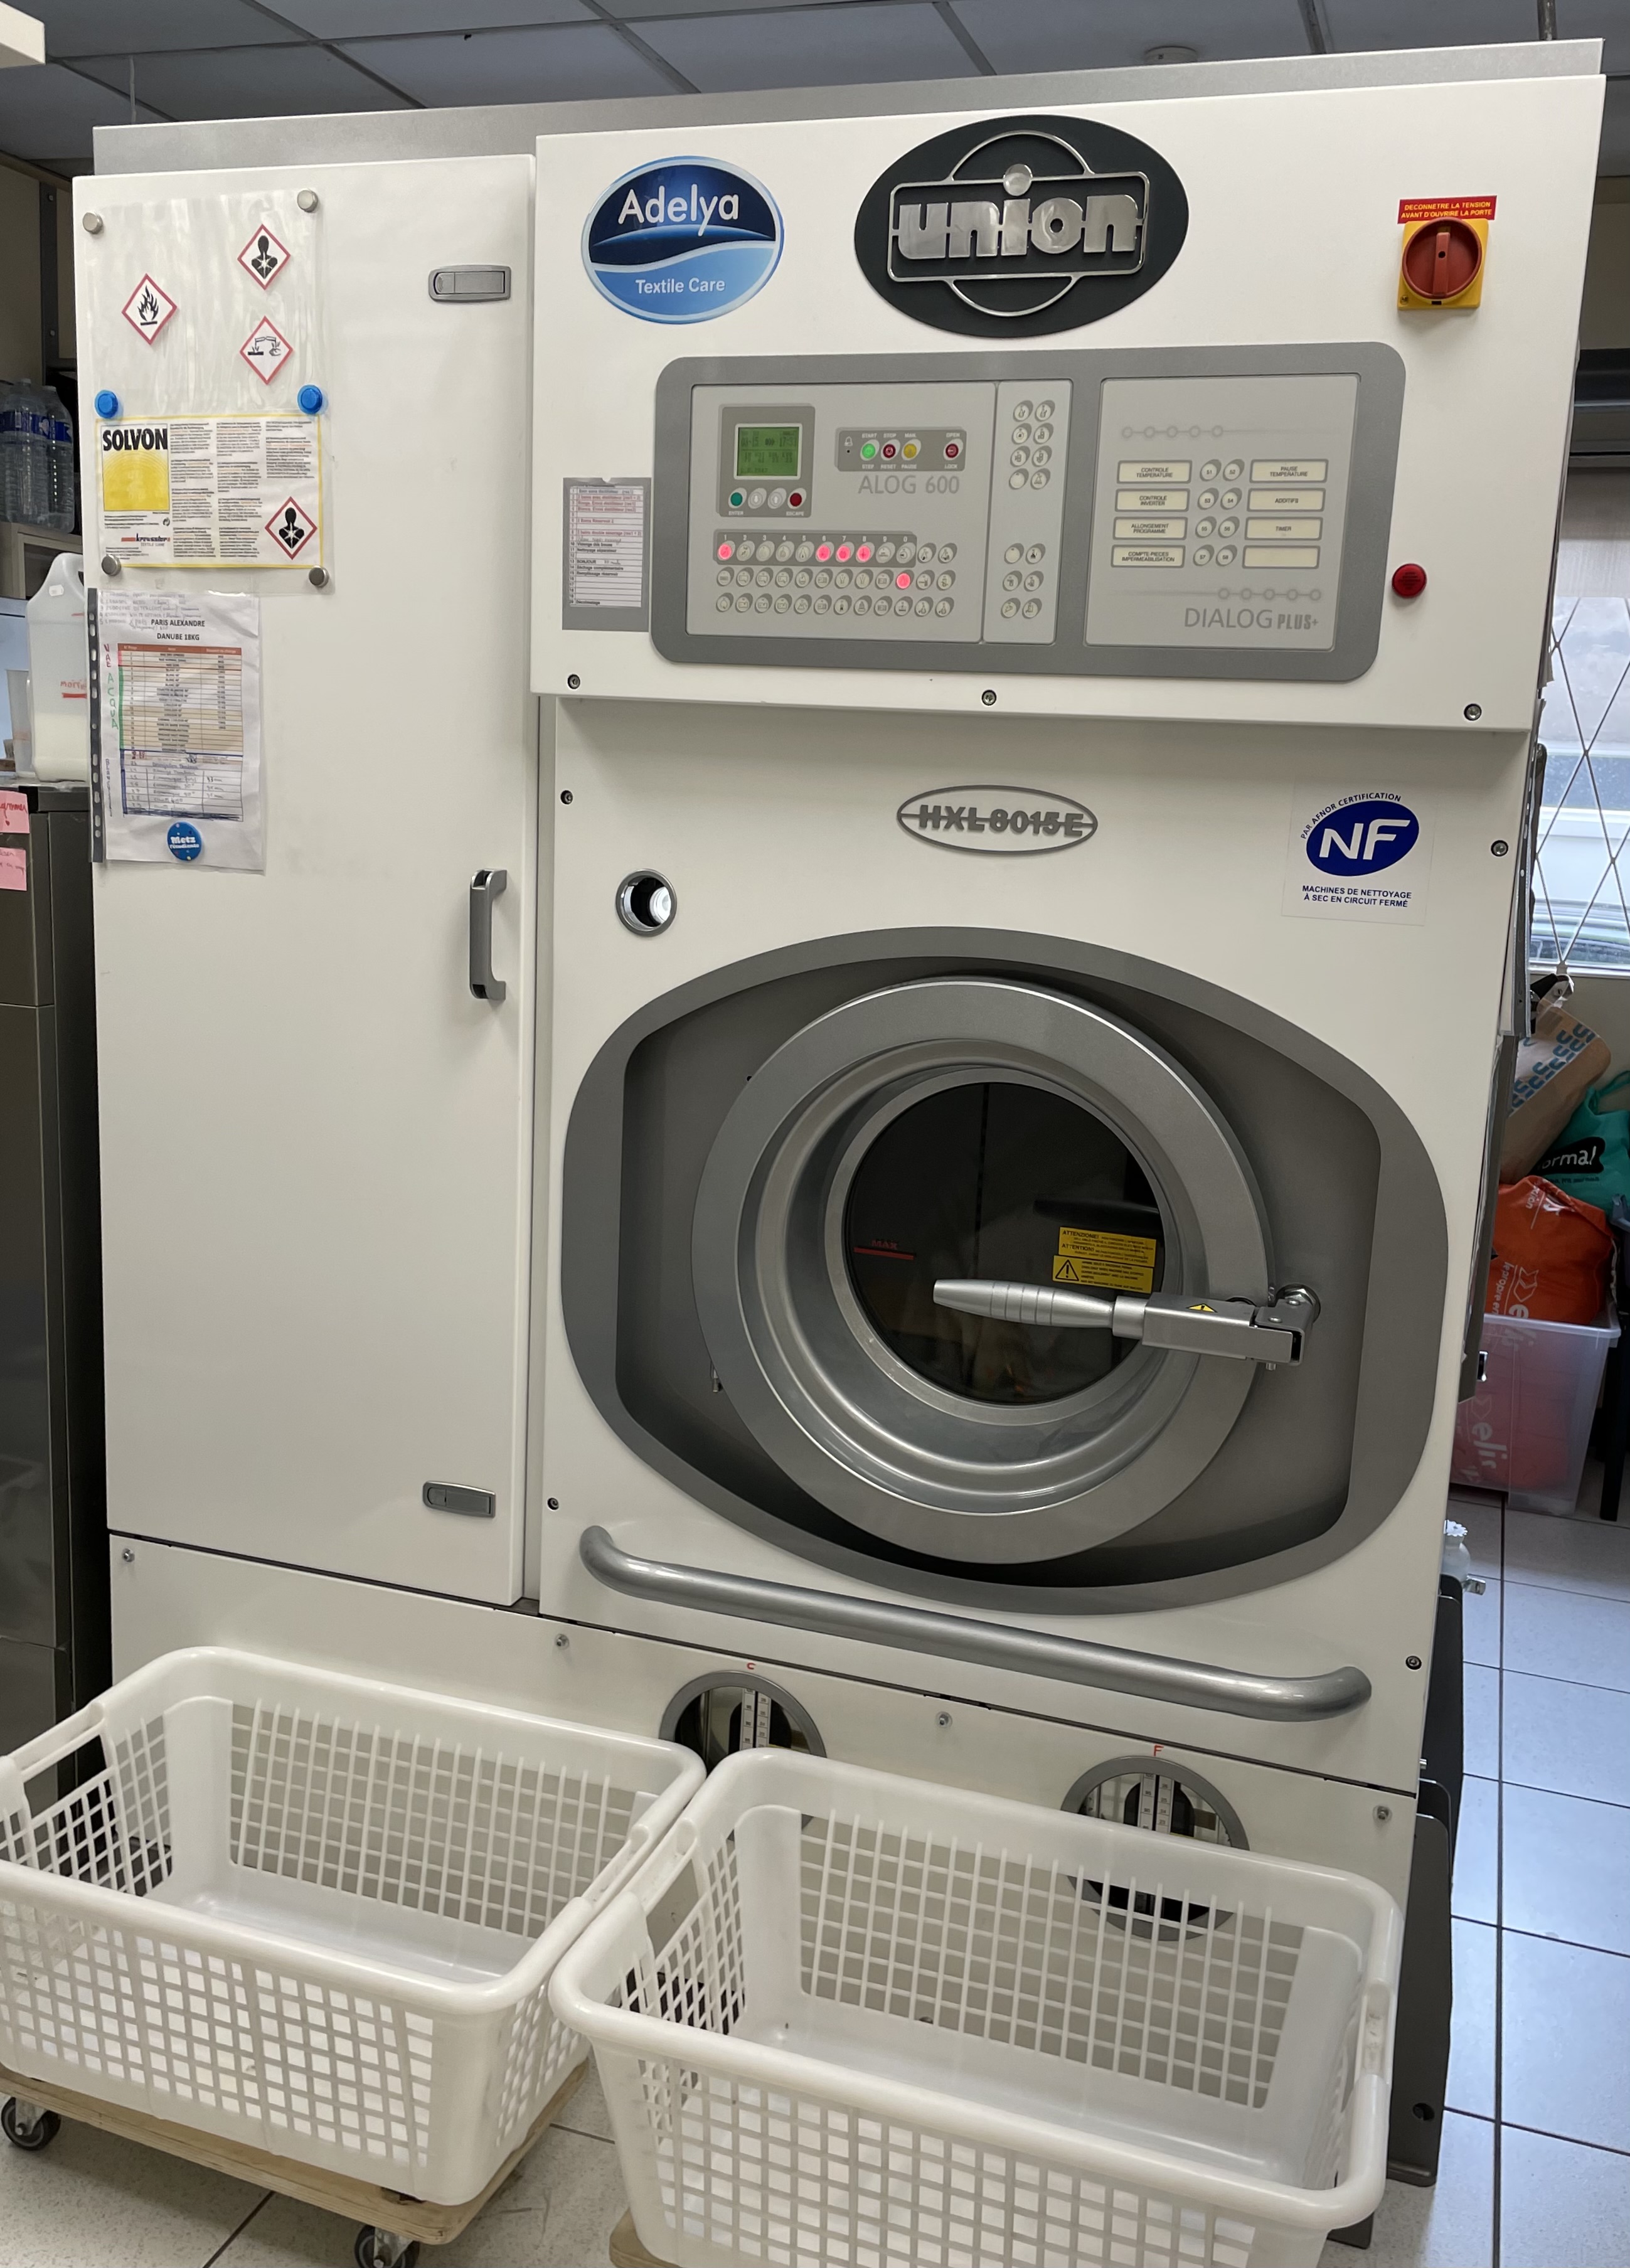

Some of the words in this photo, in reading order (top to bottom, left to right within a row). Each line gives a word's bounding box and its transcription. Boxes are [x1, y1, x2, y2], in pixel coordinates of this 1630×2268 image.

[618, 183, 739, 237] Adelya
[898, 164, 1139, 260] union
[1404, 203, 1449, 211] DECONNETRE
[635, 278, 684, 294] Textile
[688, 278, 726, 293] Care
[102, 428, 168, 451] SOLVON
[858, 475, 917, 494] ALOG
[925, 475, 960, 494] 600
[1184, 607, 1273, 629] DIALOG
[1301, 824, 1313, 839] PAR
[1311, 803, 1337, 825] AFNOR
[1338, 792, 1402, 806] CERTIFICATION
[1319, 818, 1411, 861] NF
[1302, 885, 1345, 895] MACHINES
[1347, 888, 1359, 896] DE
[1360, 889, 1412, 899] NETTOYAGE
[1303, 892, 1310, 901] À
[1311, 894, 1329, 902] SEC
[1330, 895, 1342, 903] EN
[1344, 897, 1378, 906] CIRCUIT
[1378, 899, 1409, 908] FERMÉ
[1537, 1145, 1597, 1170] ormal
[1154, 1745, 1164, 1757] F
